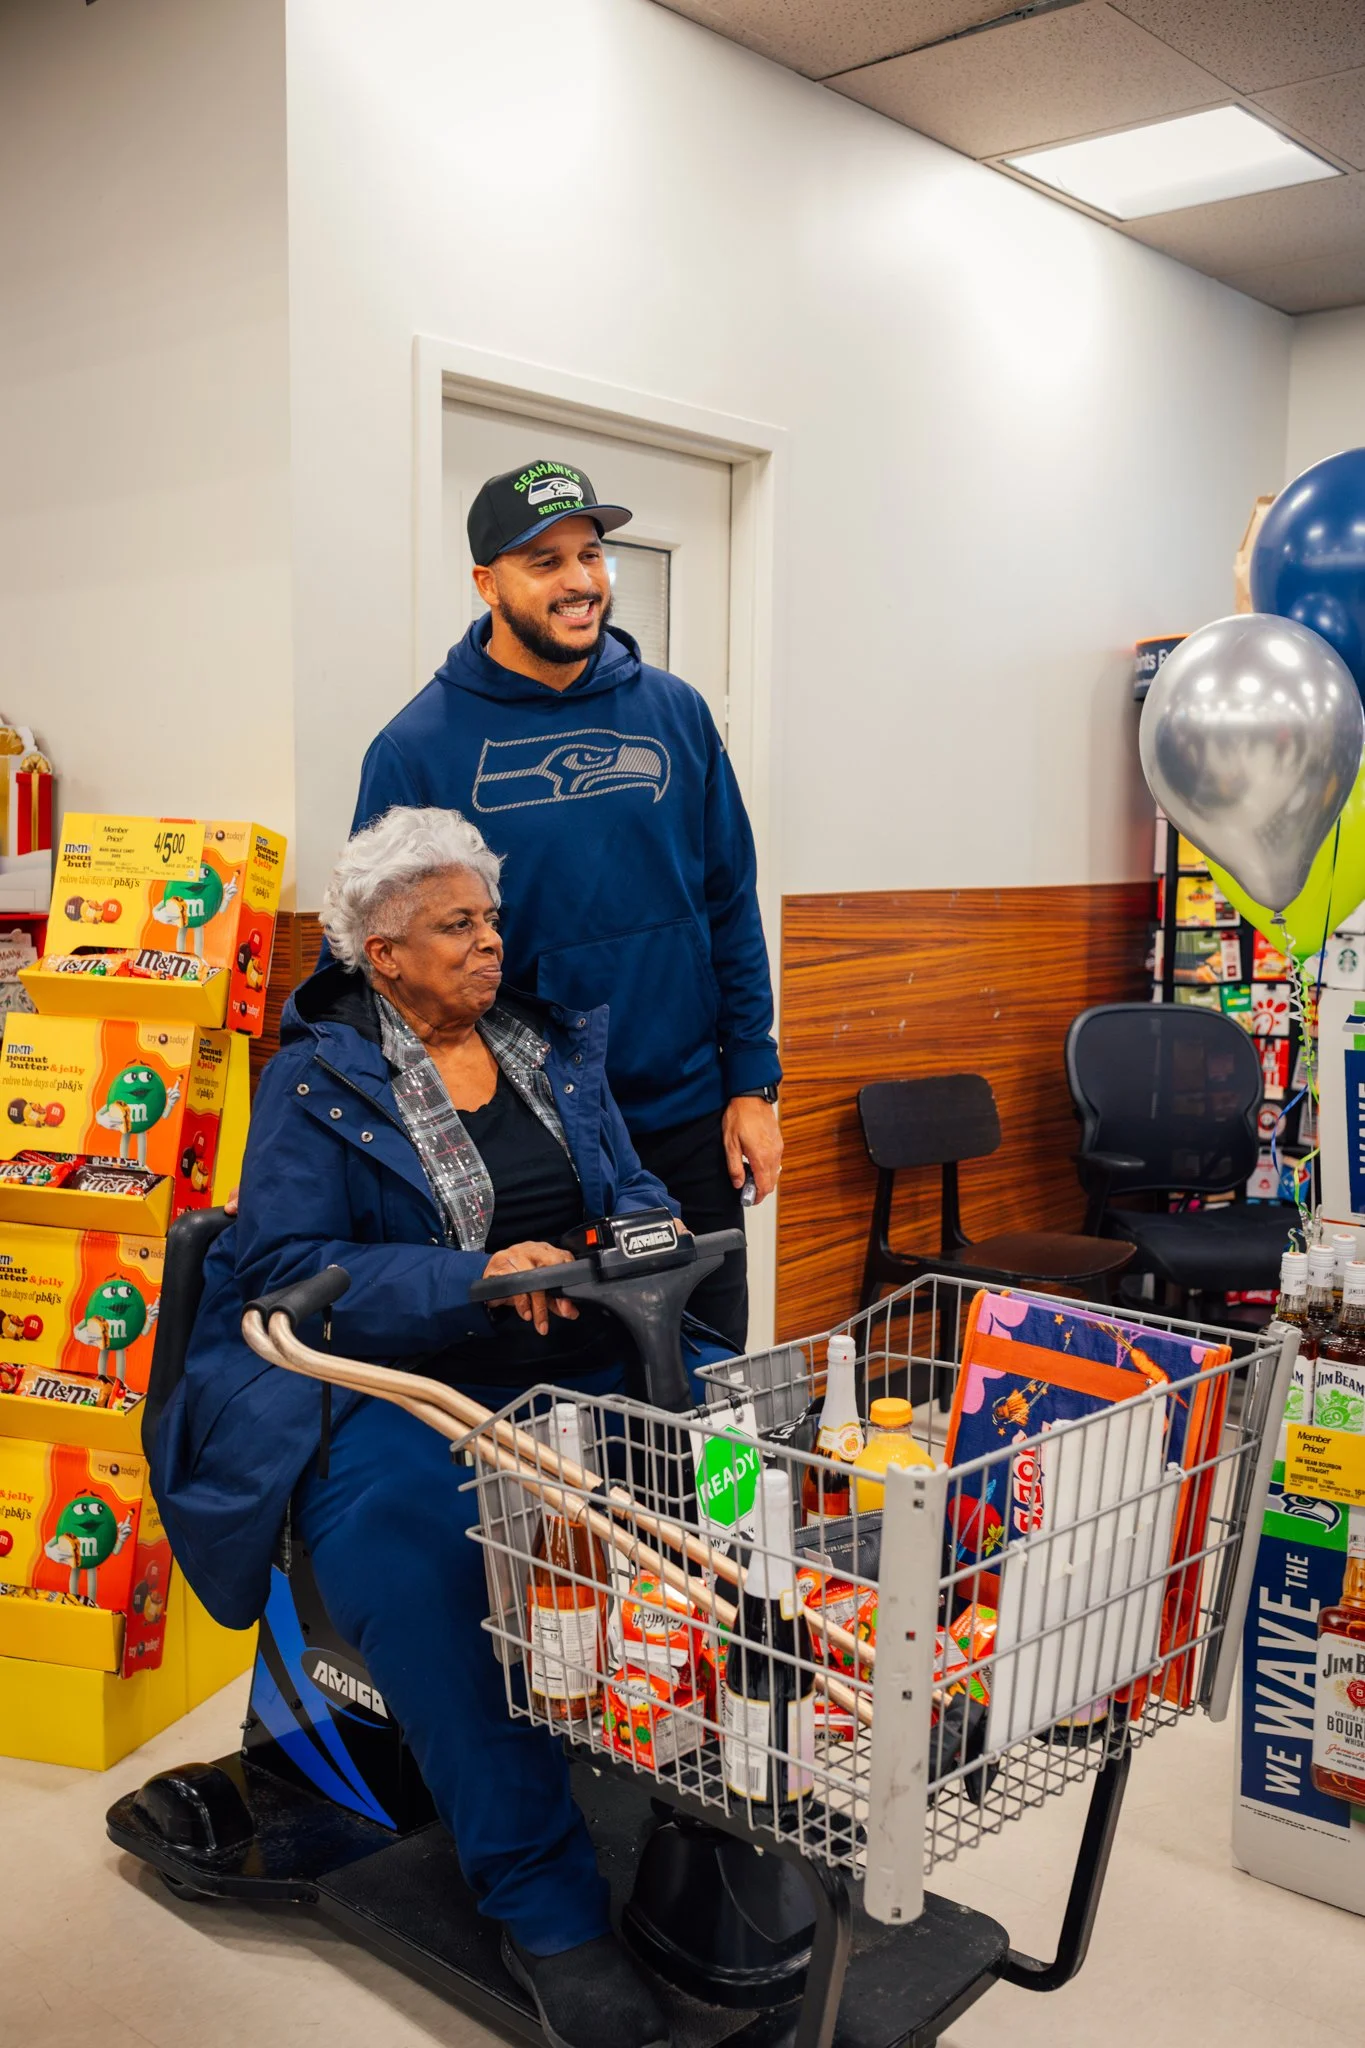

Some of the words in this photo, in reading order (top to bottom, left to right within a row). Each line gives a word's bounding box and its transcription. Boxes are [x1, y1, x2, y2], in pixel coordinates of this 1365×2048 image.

[514, 462, 580, 493] SEAHAWKS
[104, 826, 129, 834] Member
[255, 844, 279, 858] peanut
[257, 850, 279, 865] butter
[198, 1046, 223, 1057] peanut
[200, 1052, 223, 1064] butter
[6, 1055, 48, 1064] peanut
[10, 1061, 49, 1071] butter
[59, 1064, 85, 1076] jelly
[21, 1077, 33, 1086] the
[56, 1080, 84, 1093] pb&j's
[628, 1230, 673, 1251] AMIGO
[37, 1276, 64, 1288] jelly
[13, 1289, 28, 1301] days
[35, 1291, 62, 1305] pb&j's
[1316, 1371, 1333, 1388] JIM
[1335, 1370, 1364, 1397] BEAM
[1297, 1431, 1332, 1444] Member
[1302, 1443, 1326, 1455] Price!
[1304, 1458, 1318, 1466] BEAM
[1318, 1461, 1342, 1470] BOURBON
[1306, 1466, 1329, 1475] STRAIGHT
[700, 1447, 756, 1504] READY
[6, 1490, 34, 1503] jelly
[5, 1507, 32, 1520] pb&j's
[1285, 1552, 1309, 1588] THE
[1255, 1586, 1320, 1740] WAVE
[1322, 1653, 1353, 1678] JIM
[312, 1659, 389, 1719] AMIGO
[1334, 1710, 1359, 1722] KENTUCKY
[1265, 1745, 1302, 1796] WE
